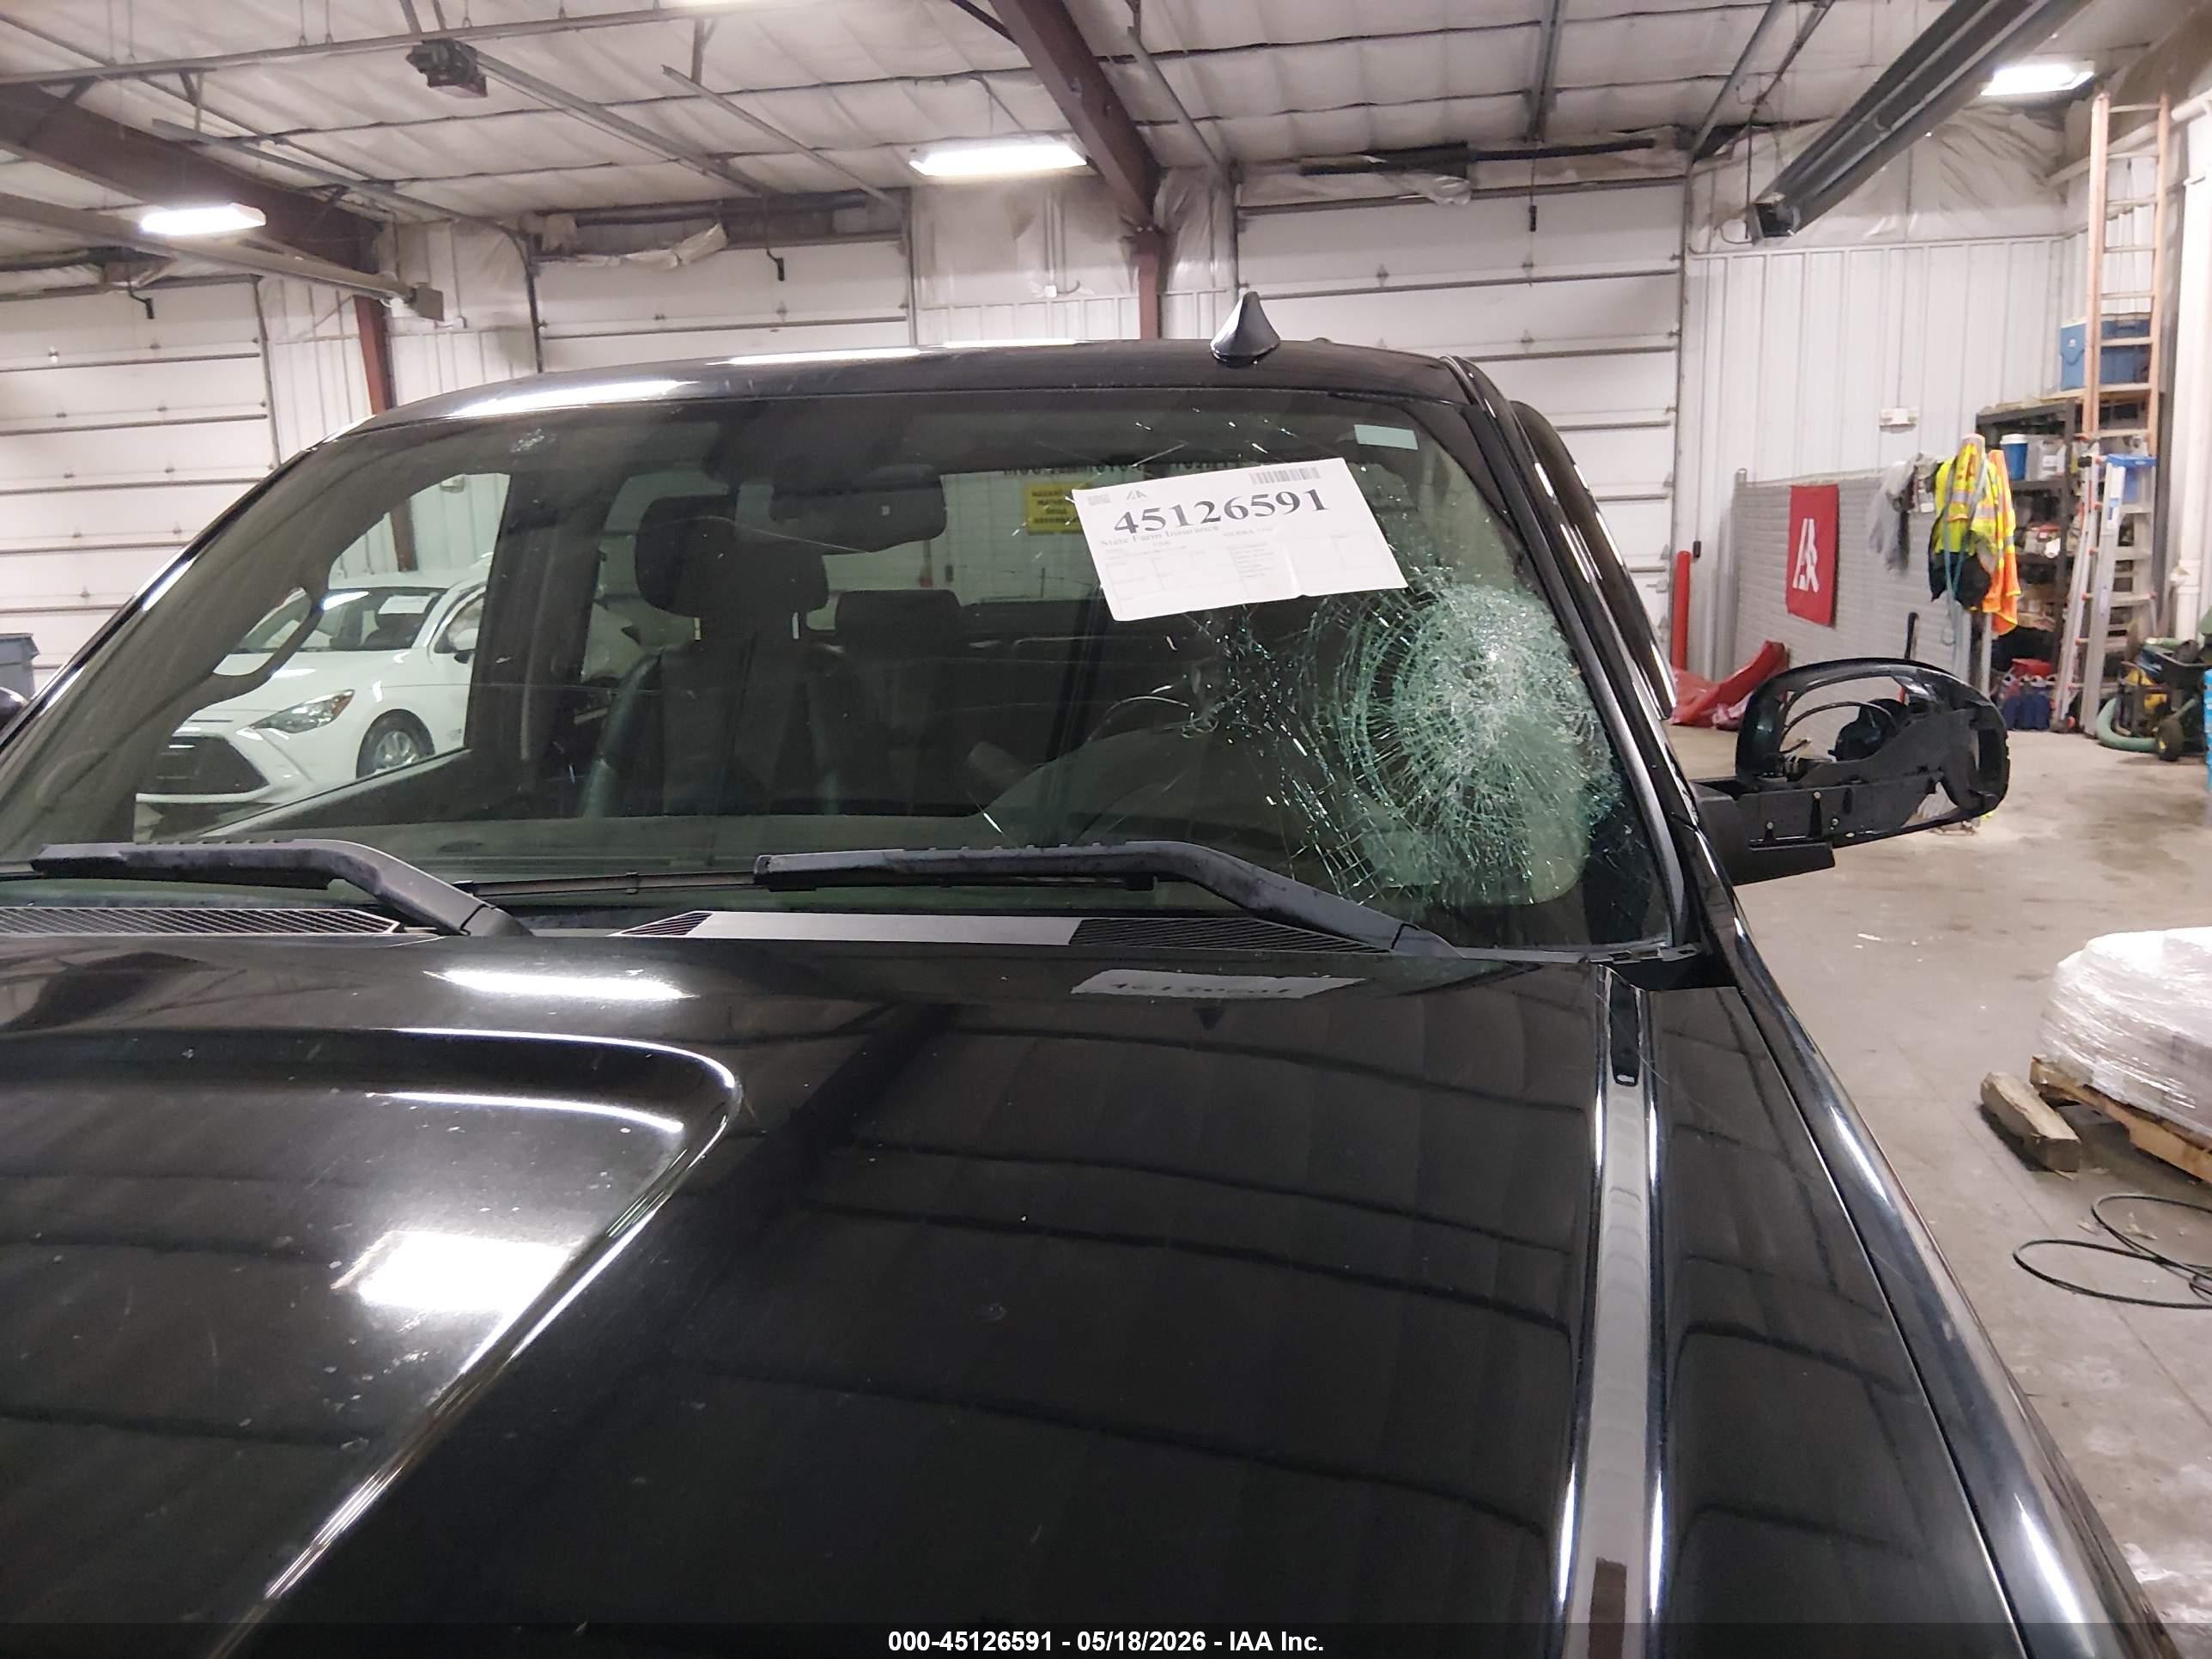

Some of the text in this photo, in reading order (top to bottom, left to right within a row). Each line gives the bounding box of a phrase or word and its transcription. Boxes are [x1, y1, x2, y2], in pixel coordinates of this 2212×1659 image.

[1114, 489, 1329, 534] 45126591
[1132, 532, 1162, 543] Farm
[1166, 526, 1219, 538] Insurance
